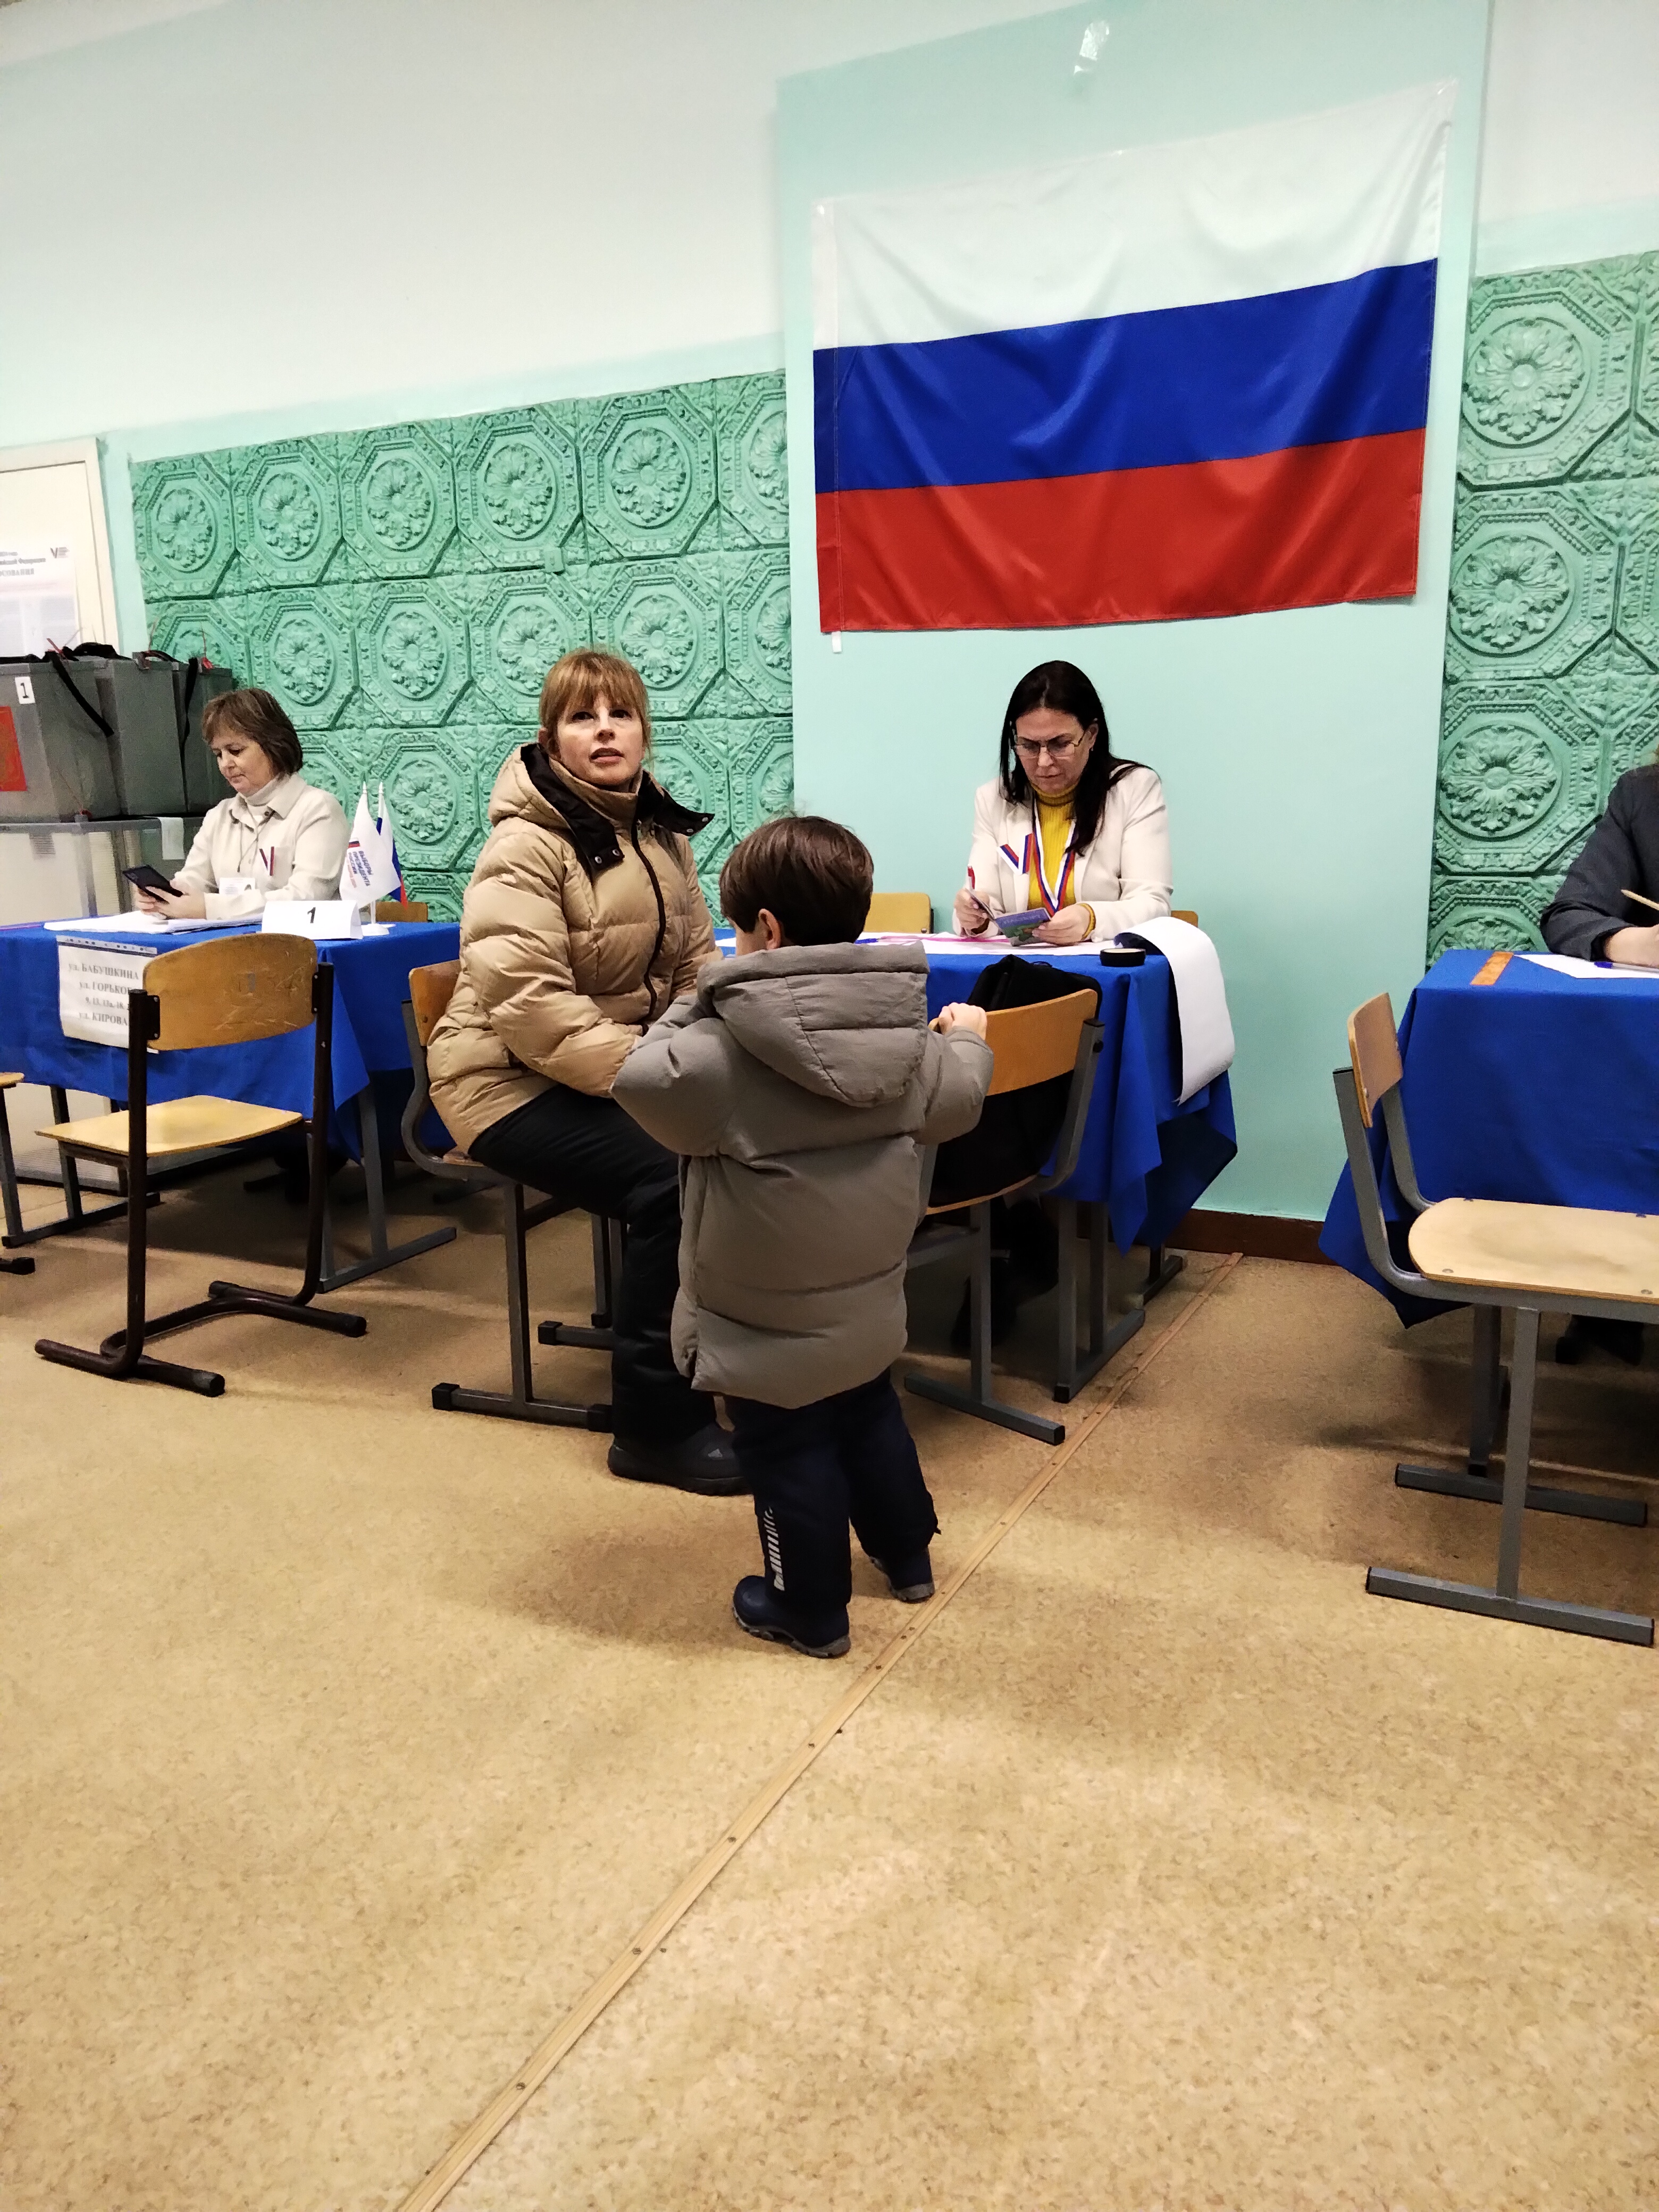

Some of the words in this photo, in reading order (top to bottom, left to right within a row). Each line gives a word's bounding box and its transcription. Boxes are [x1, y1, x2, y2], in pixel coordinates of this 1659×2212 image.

[20, 682, 28, 698] 1
[348, 852, 357, 875] РОССИИ
[353, 851, 371, 887] ПРЕЗИДЕНТА
[358, 850, 373, 875] ВЫБОРЫ
[307, 907, 316, 924] 1
[81, 963, 139, 979] БАБУШКИНА
[92, 982, 142, 995] ГОРЬКО
[92, 1012, 128, 1026] КИРОВА
